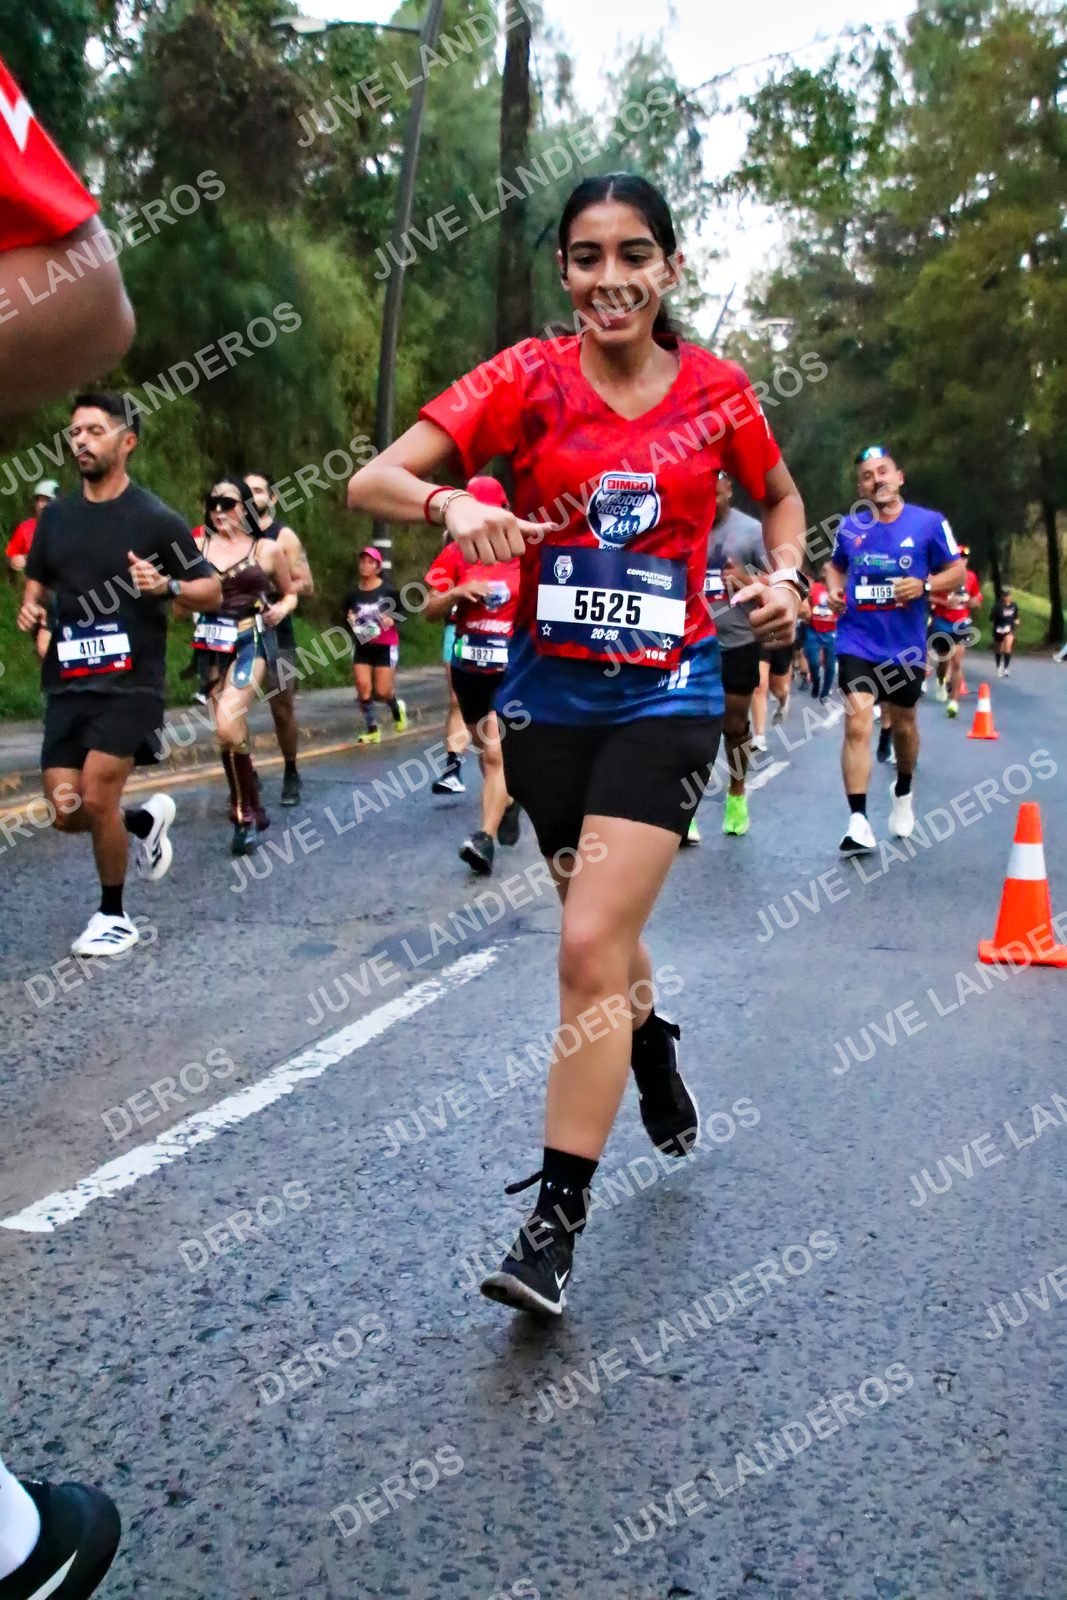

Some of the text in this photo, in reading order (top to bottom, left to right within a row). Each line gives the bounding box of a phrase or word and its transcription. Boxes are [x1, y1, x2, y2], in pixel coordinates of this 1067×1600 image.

[606, 479, 649, 491] BIMBO
[871, 586, 892, 598] 4159
[574, 589, 642, 625] 5525
[80, 639, 105, 656] 4174
[645, 649, 667, 662] 10K
